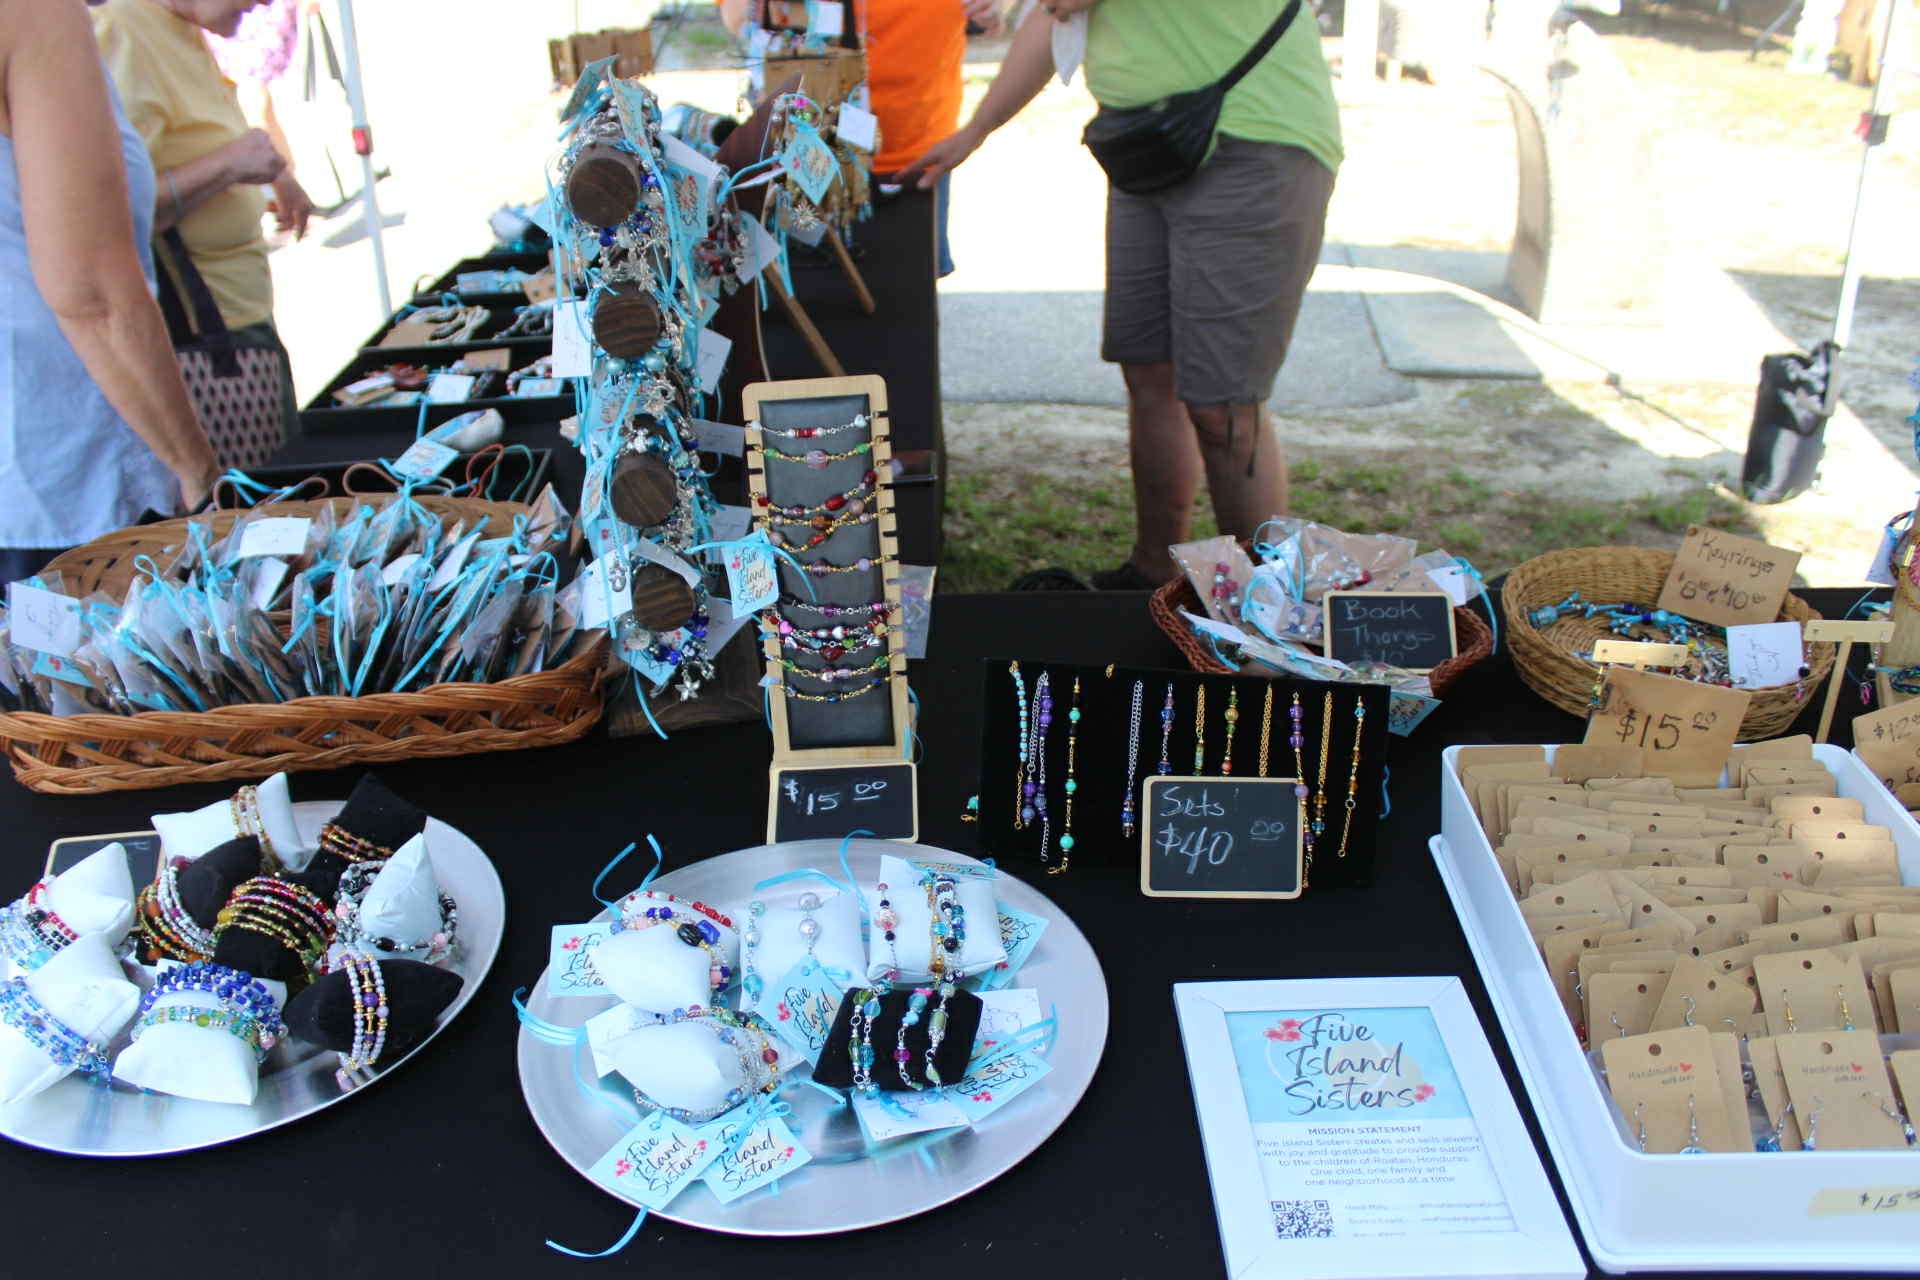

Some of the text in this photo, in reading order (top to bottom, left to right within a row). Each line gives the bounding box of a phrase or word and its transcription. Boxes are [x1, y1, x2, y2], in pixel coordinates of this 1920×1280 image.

[1344, 598, 1422, 620] Book
[1298, 1013, 1375, 1050] Five
[1285, 1042, 1404, 1082] Island
[1284, 1076, 1416, 1117] Sisters
[1256, 1138, 1279, 1147] Five
[1315, 1137, 1351, 1146] Sisters
[1308, 1126, 1421, 1136] MISSION STATEMENT
[624, 1133, 660, 1165] Five
[634, 1131, 687, 1184] Island
[1263, 1148, 1286, 1157] with
[1288, 1149, 1304, 1158] joy
[1307, 1148, 1328, 1156] and
[1331, 1147, 1379, 1157] gratitude
[1396, 1145, 1436, 1155] provide
[1439, 1145, 1481, 1154] support
[1279, 1159, 1290, 1167] to
[1293, 1158, 1311, 1166] the
[1313, 1157, 1357, 1165] children
[648, 1146, 705, 1197] Sisters
[722, 1150, 788, 1192] Sisters
[1304, 1178, 1326, 1186] one
[1328, 1177, 1405, 1187] neighborhood
[1310, 1167, 1333, 1176] One
[1367, 1166, 1388, 1174] one
[1390, 1165, 1423, 1175] family
[1426, 1164, 1446, 1173] and
